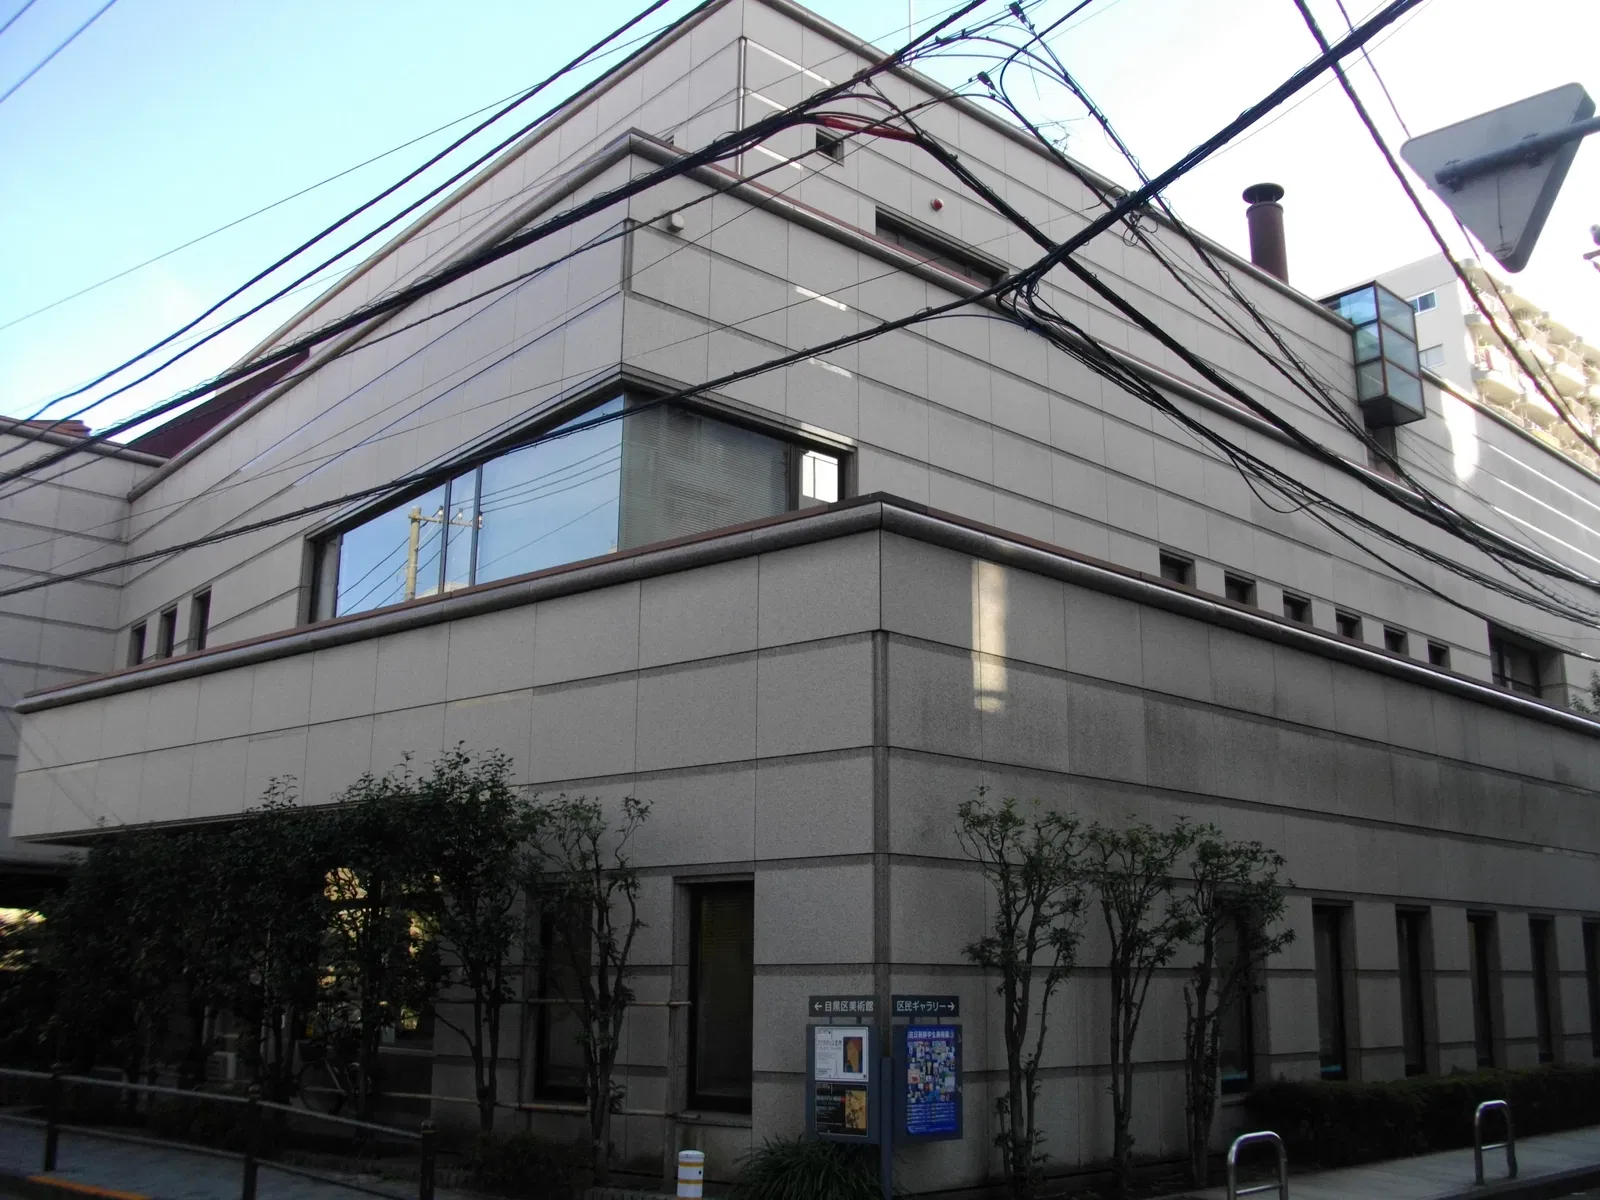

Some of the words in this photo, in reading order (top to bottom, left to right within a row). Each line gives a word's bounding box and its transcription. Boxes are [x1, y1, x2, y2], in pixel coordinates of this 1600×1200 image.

[825, 1001, 874, 1012] 目黒区美術館
[896, 1000, 946, 1012] 区民ギャラリー
